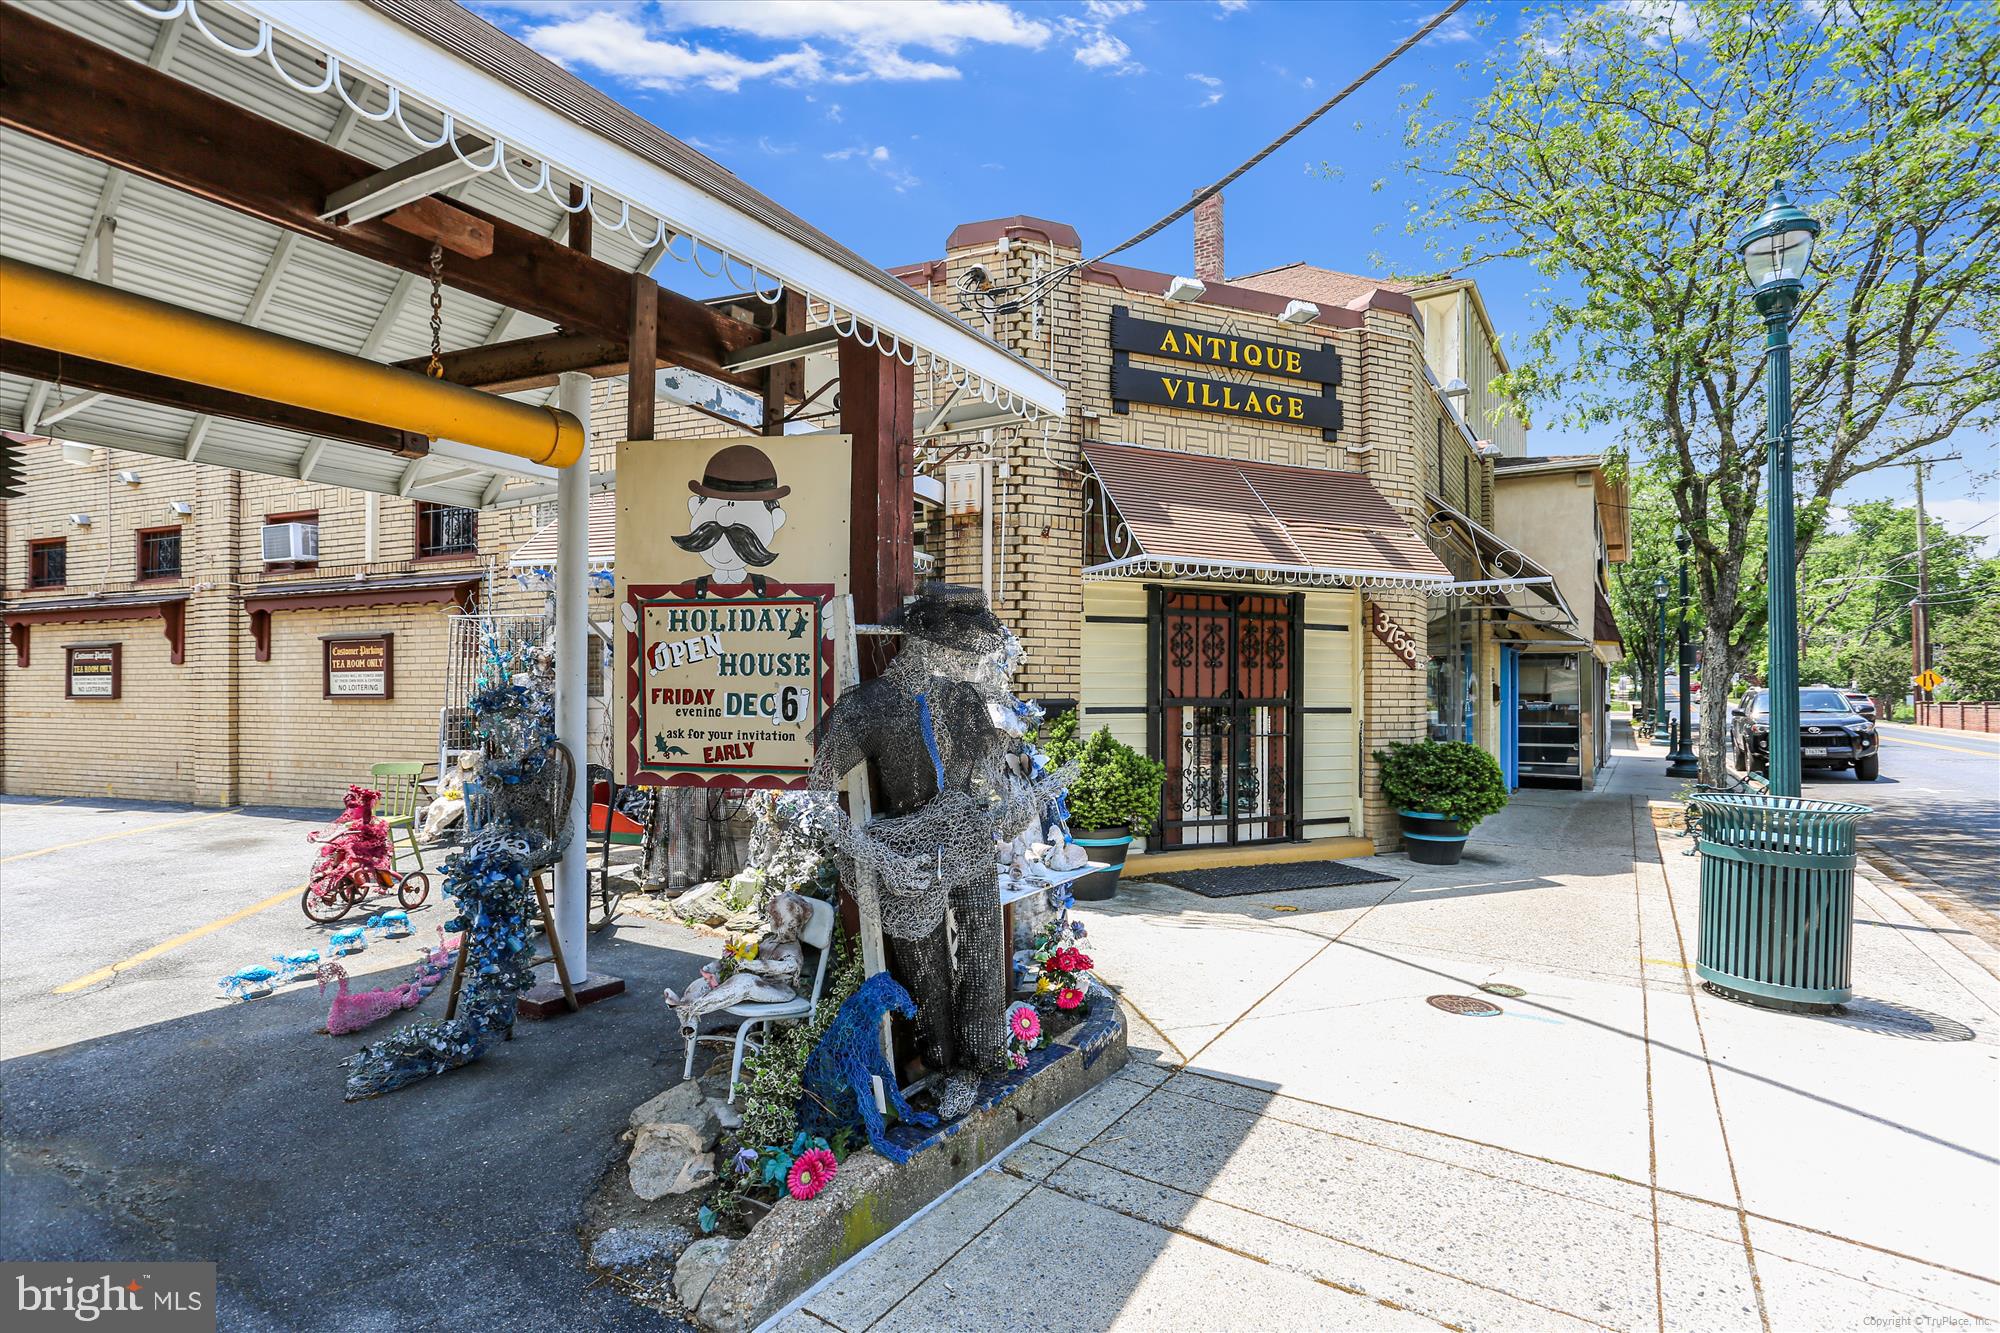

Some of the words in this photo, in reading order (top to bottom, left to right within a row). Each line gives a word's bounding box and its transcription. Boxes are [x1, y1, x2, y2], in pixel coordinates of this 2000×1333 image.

[1160, 329, 1302, 374] ANTIQUE
[1160, 377, 1304, 419] VILLAGE
[669, 608, 791, 632] HOLIDAY
[1376, 612, 1416, 660] 3758
[332, 646, 359, 656] Customer
[359, 645, 384, 657] Parking
[332, 659, 346, 668] TEA
[346, 659, 365, 668] ROOM
[366, 658, 384, 668] ONLY
[653, 631, 725, 672] OPEN
[74, 665, 84, 673] TEA
[84, 665, 99, 673] ROOM
[718, 652, 810, 677] HOUSE
[651, 688, 715, 705] FRIDAY
[726, 692, 777, 716] DEC
[781, 686, 798, 722] 6
[666, 728, 685, 739] ask
[688, 729, 705, 739] for
[707, 731, 734, 741] your
[737, 730, 796, 741] invitation
[703, 742, 755, 763] EARLY
